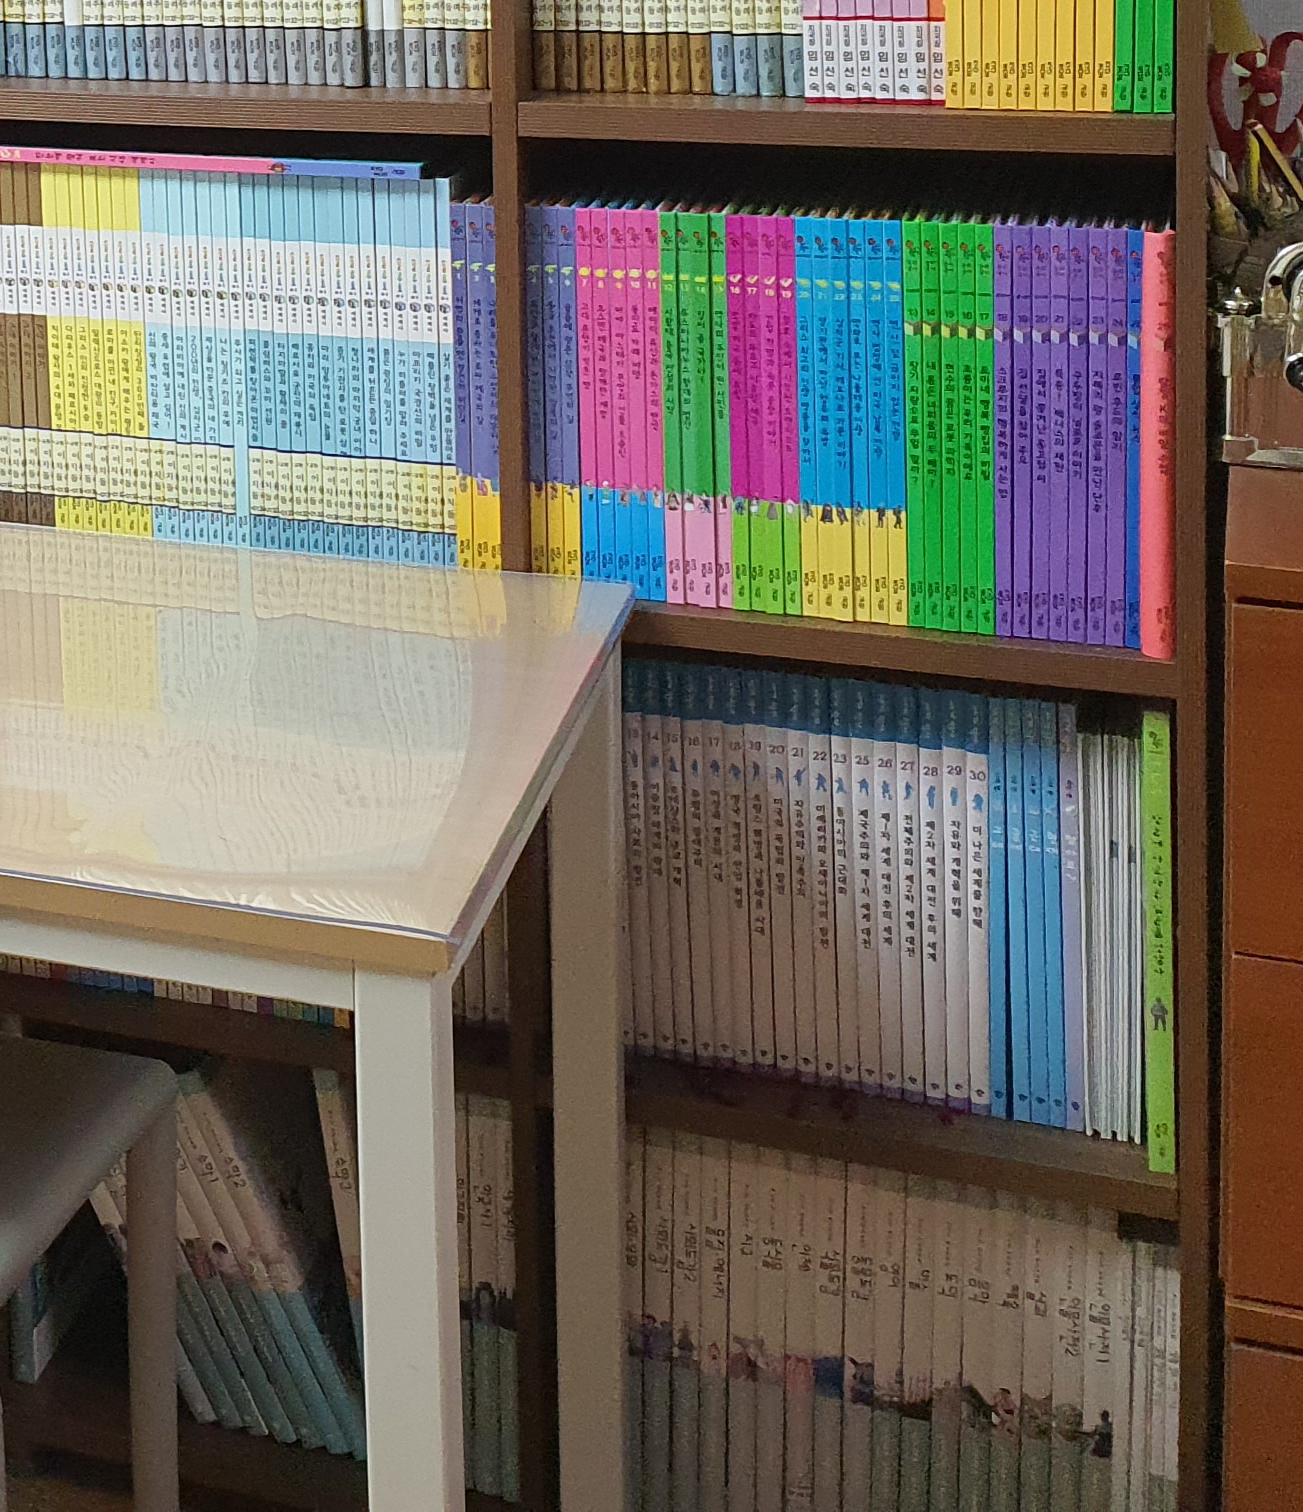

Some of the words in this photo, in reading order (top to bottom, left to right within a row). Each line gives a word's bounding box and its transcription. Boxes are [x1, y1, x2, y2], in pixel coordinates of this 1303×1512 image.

[748, 741, 761, 751] 19
[769, 746, 785, 755] 20
[791, 747, 804, 758] 21
[812, 751, 827, 761] 22
[833, 754, 847, 764] 23
[855, 755, 870, 766] 25
[877, 758, 893, 769] 26
[900, 761, 915, 771] 27
